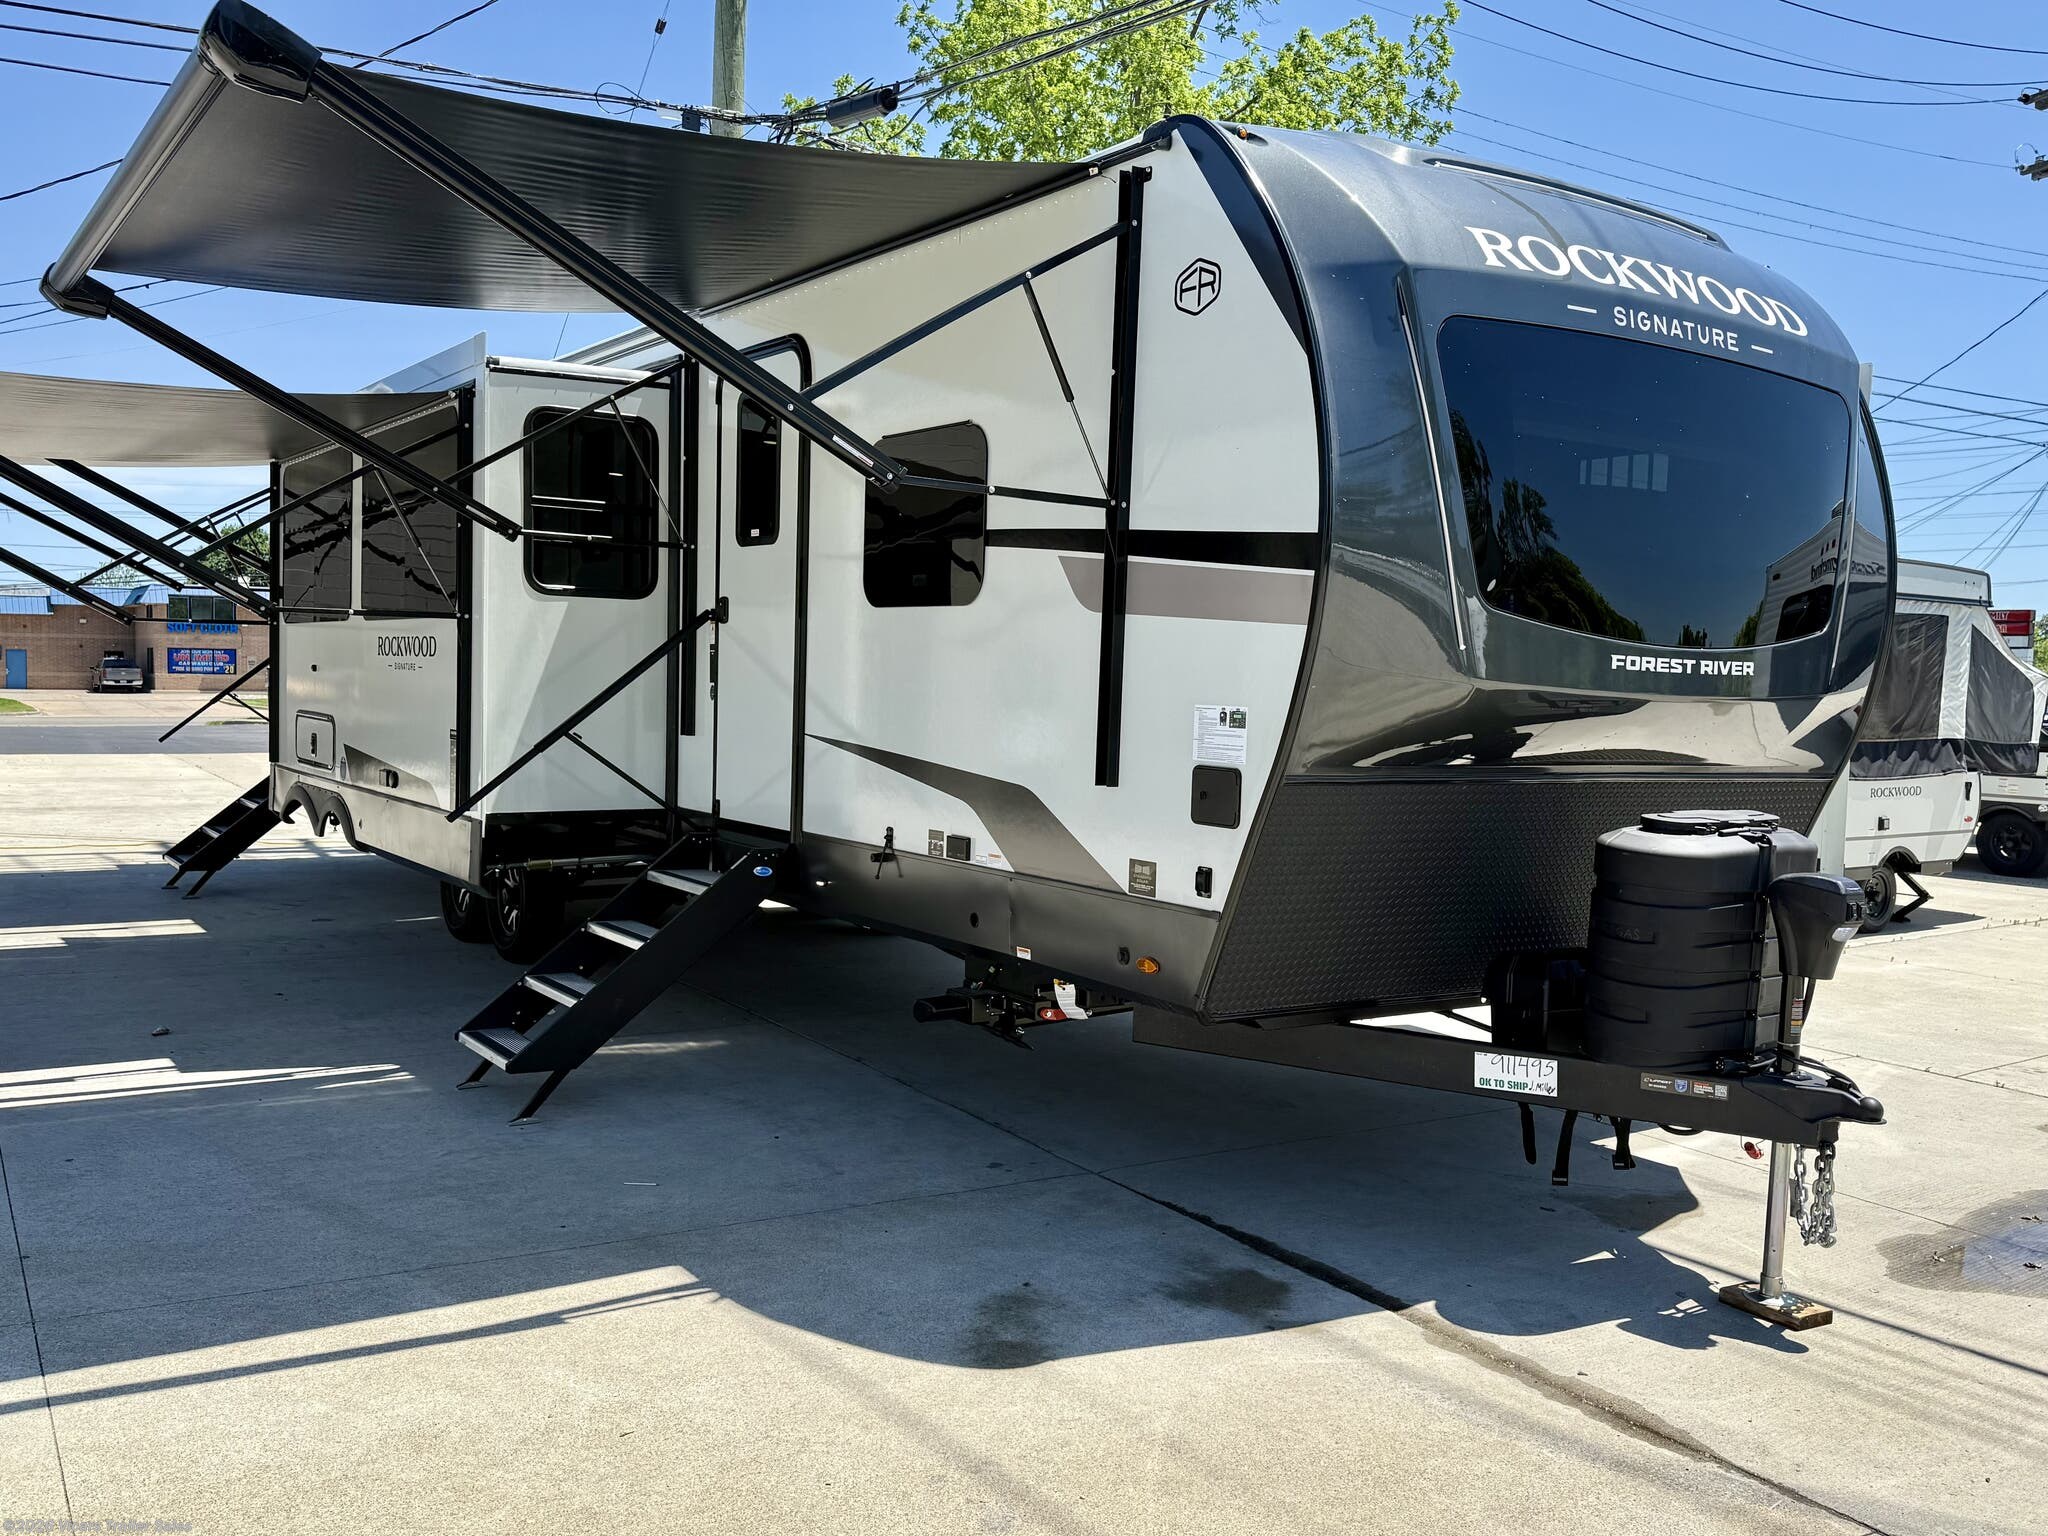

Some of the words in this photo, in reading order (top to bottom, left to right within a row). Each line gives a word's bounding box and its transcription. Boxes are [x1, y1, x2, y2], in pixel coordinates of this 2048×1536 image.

[1464, 226, 1808, 337] ROCKWOOD
[1613, 306, 1739, 352] SIGNATURE
[377, 635, 437, 657] ROCKWOOD
[1611, 654, 1696, 674] FOREST
[1700, 660, 1754, 676] RIVER
[1870, 785, 1922, 798] ROCKWOOD
[1490, 1054, 1554, 1078] 911495
[1479, 1077, 1492, 1087] OK
[1493, 1079, 1505, 1088] TO
[1507, 1080, 1529, 1091] SHIP
